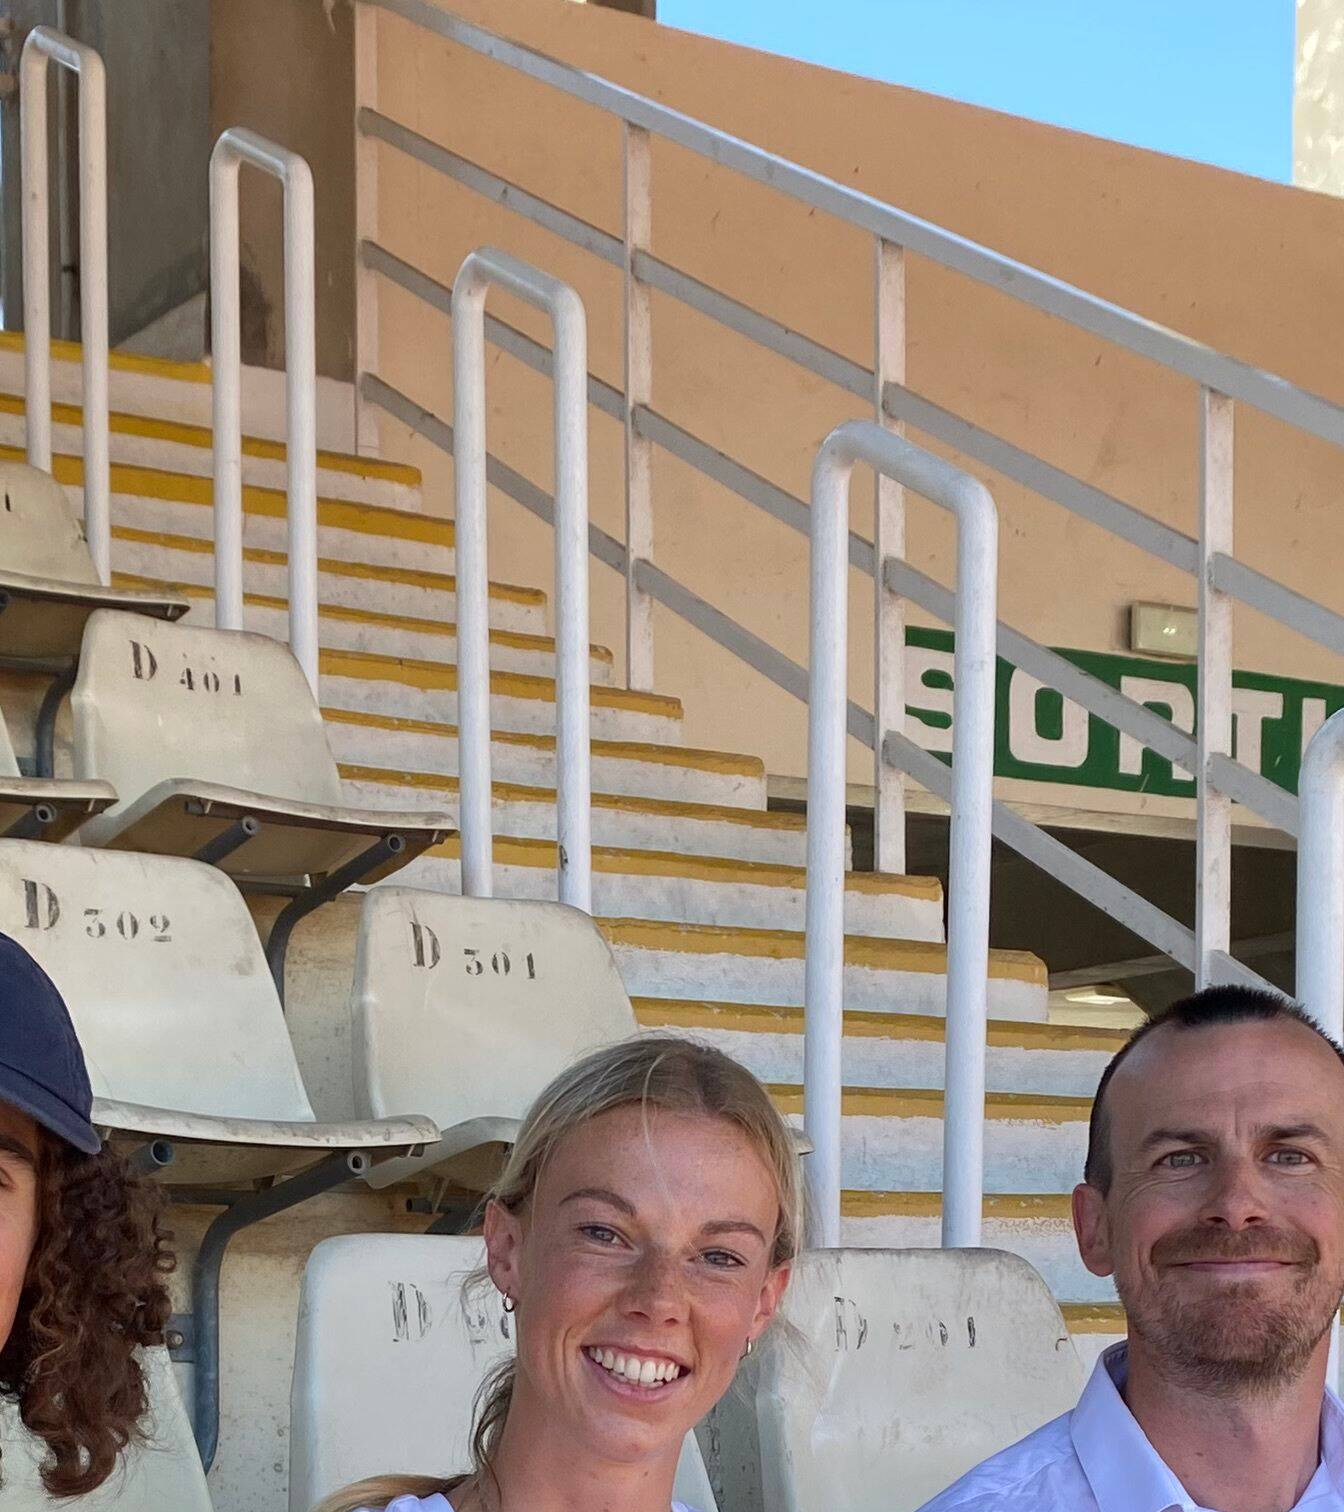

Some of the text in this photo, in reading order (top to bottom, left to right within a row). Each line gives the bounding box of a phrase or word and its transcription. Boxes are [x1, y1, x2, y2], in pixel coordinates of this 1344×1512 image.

[130, 640, 241, 695] D 401
[21, 879, 171, 942] D 302
[409, 918, 535, 979] D 301
